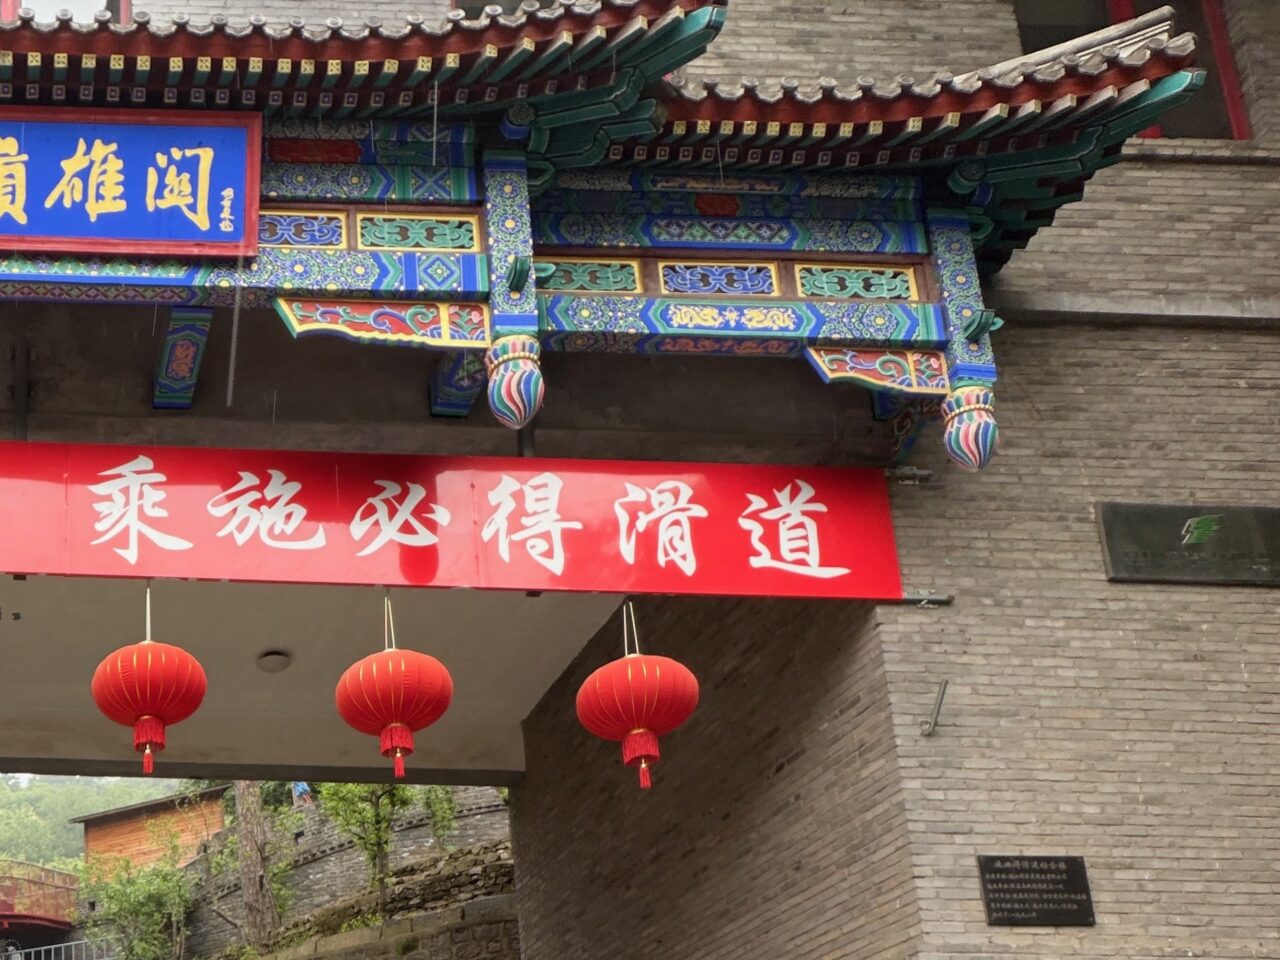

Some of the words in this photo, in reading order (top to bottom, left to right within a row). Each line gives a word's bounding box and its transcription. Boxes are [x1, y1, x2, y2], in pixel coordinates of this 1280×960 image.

[87, 454, 851, 577] 乘施必得滑道
